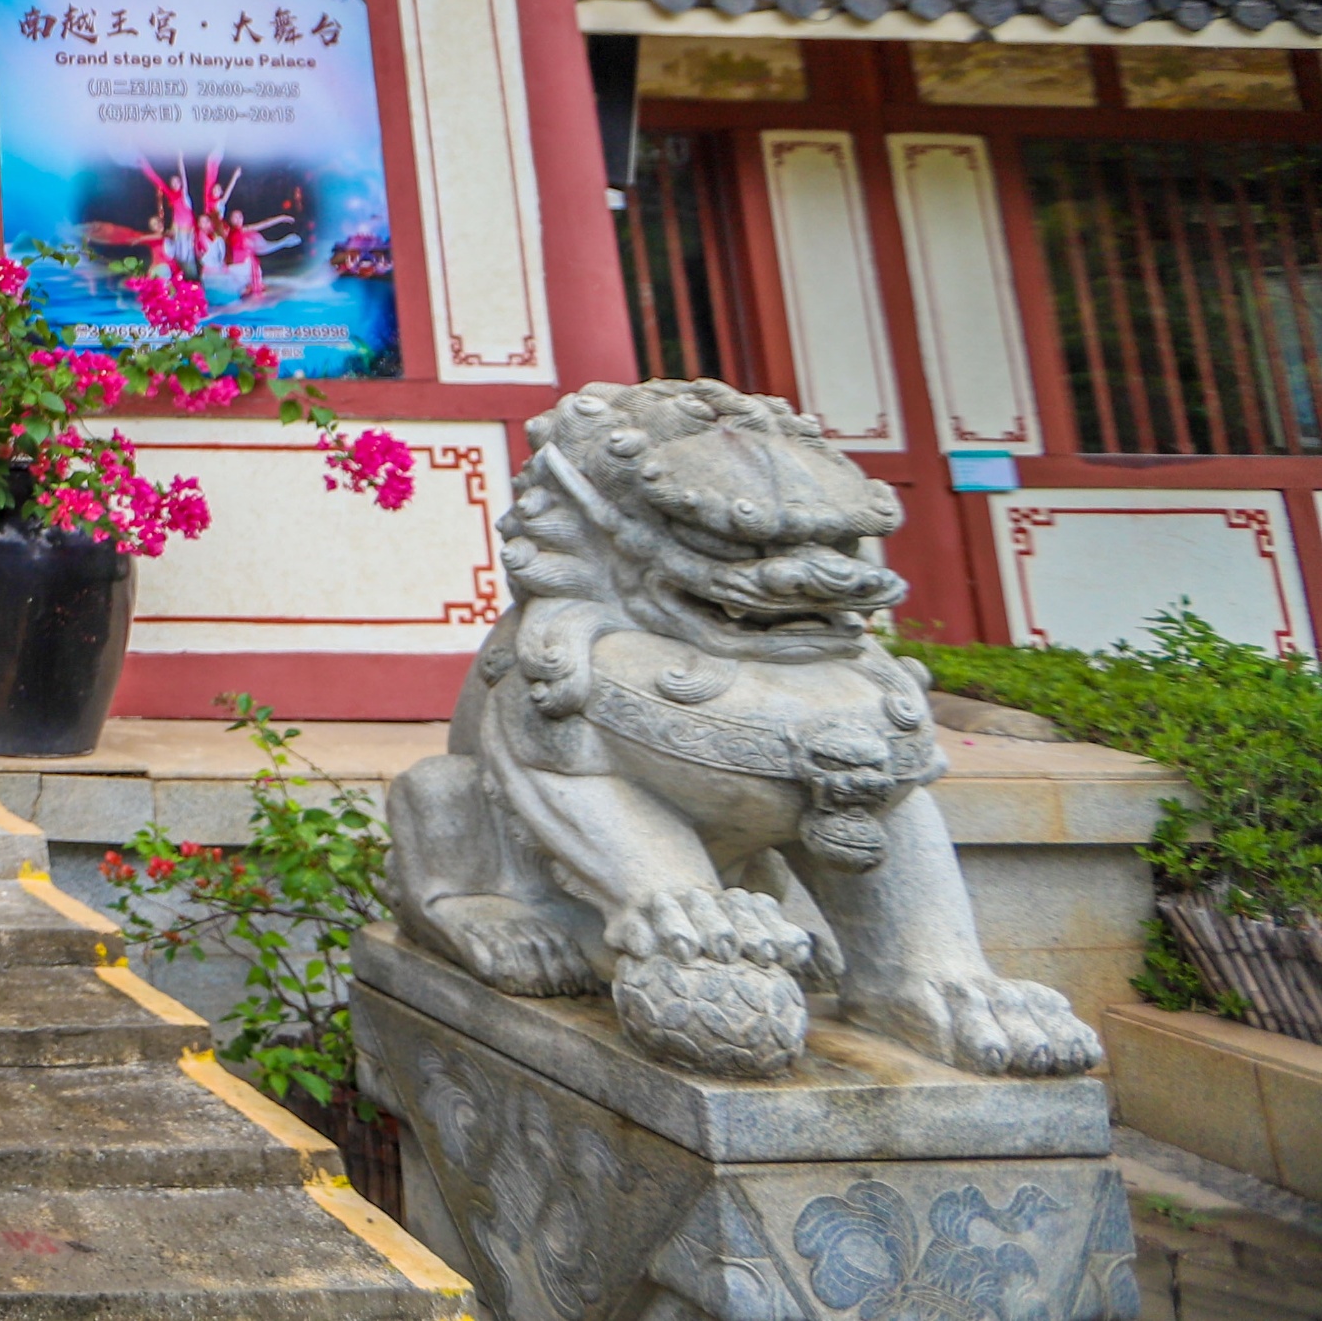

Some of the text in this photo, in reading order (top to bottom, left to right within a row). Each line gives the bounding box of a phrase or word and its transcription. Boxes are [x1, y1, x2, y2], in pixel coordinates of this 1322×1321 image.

[56, 51, 317, 71] Grand stage of Nanyue Palace
